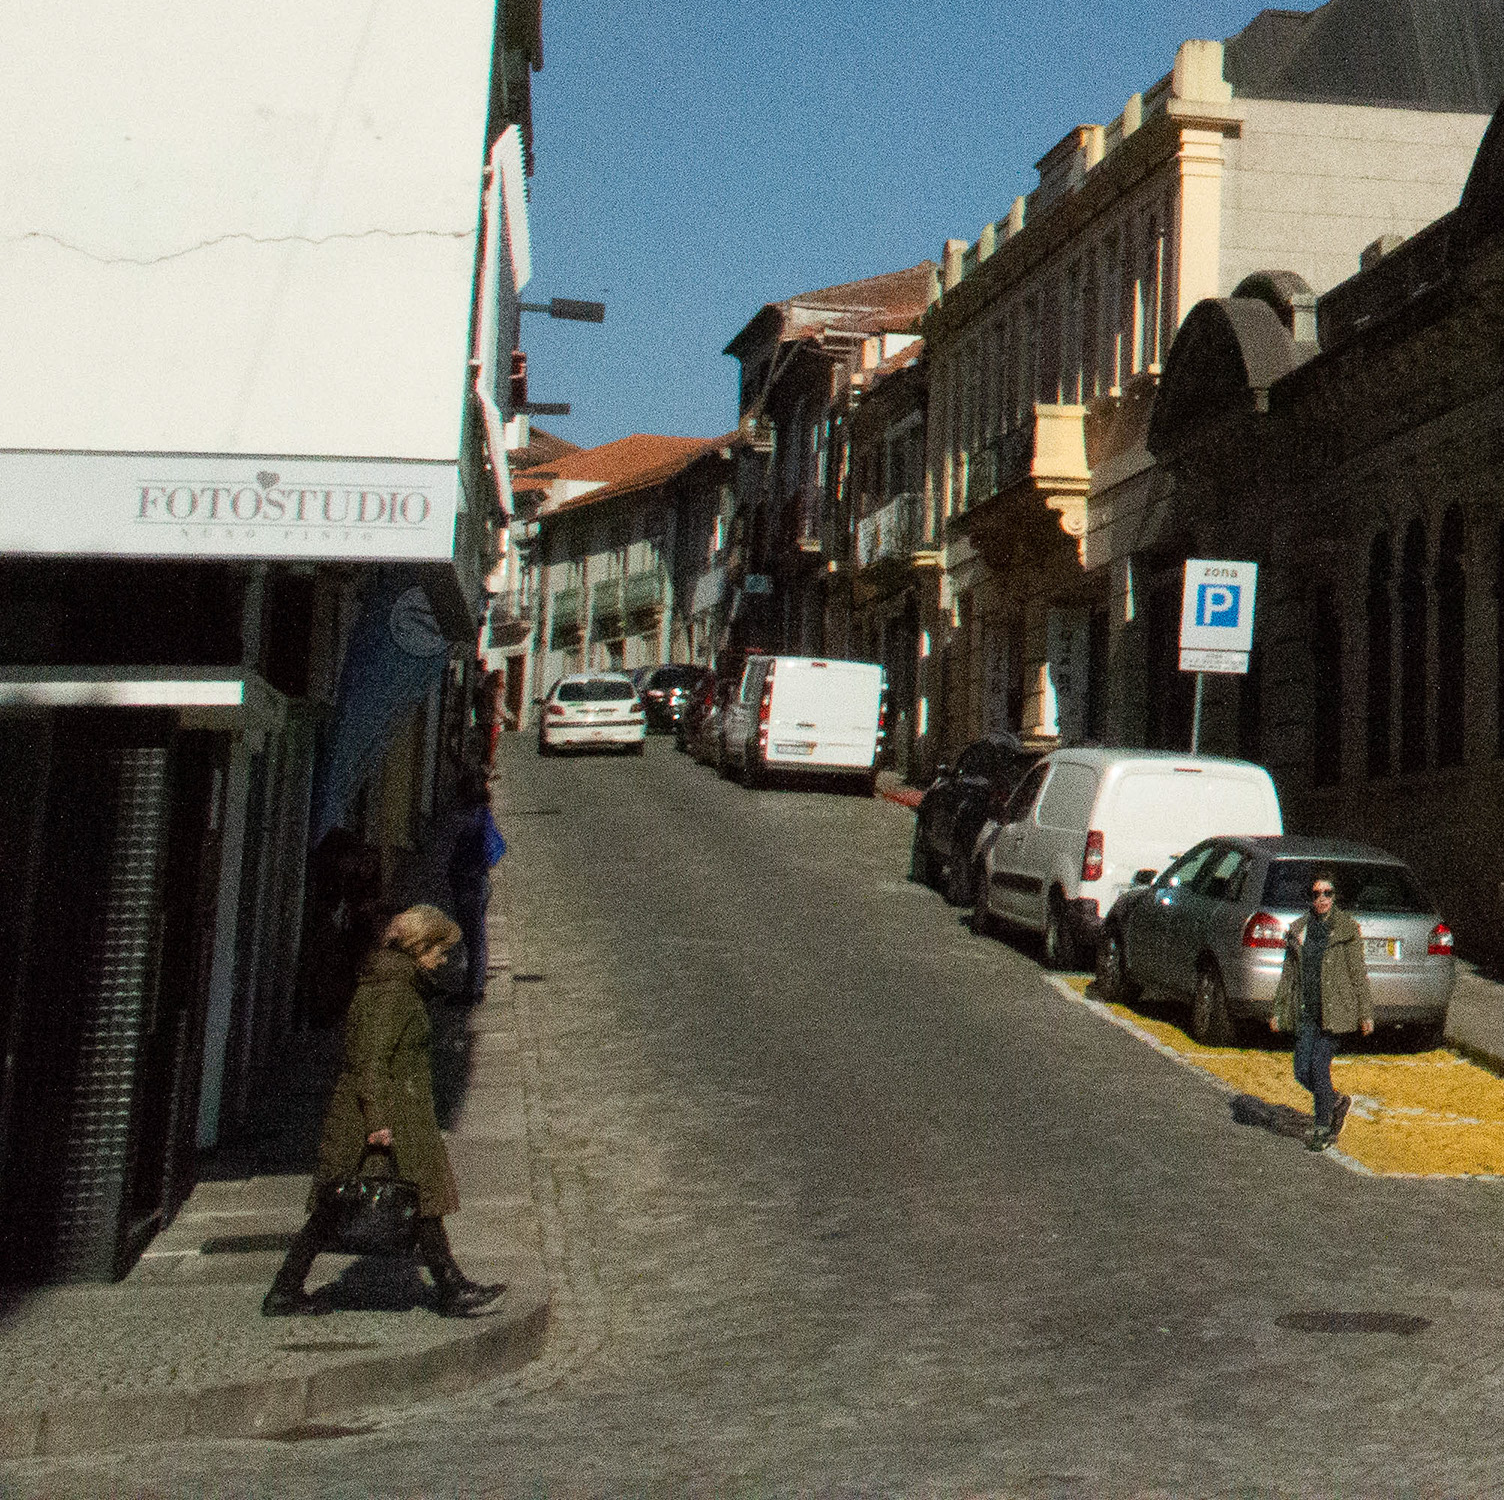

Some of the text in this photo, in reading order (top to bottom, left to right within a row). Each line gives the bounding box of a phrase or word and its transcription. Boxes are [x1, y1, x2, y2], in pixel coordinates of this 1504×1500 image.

[137, 486, 431, 524] FOTOSTUDIO
[1204, 567, 1238, 578] zona
[1203, 587, 1233, 624] P
